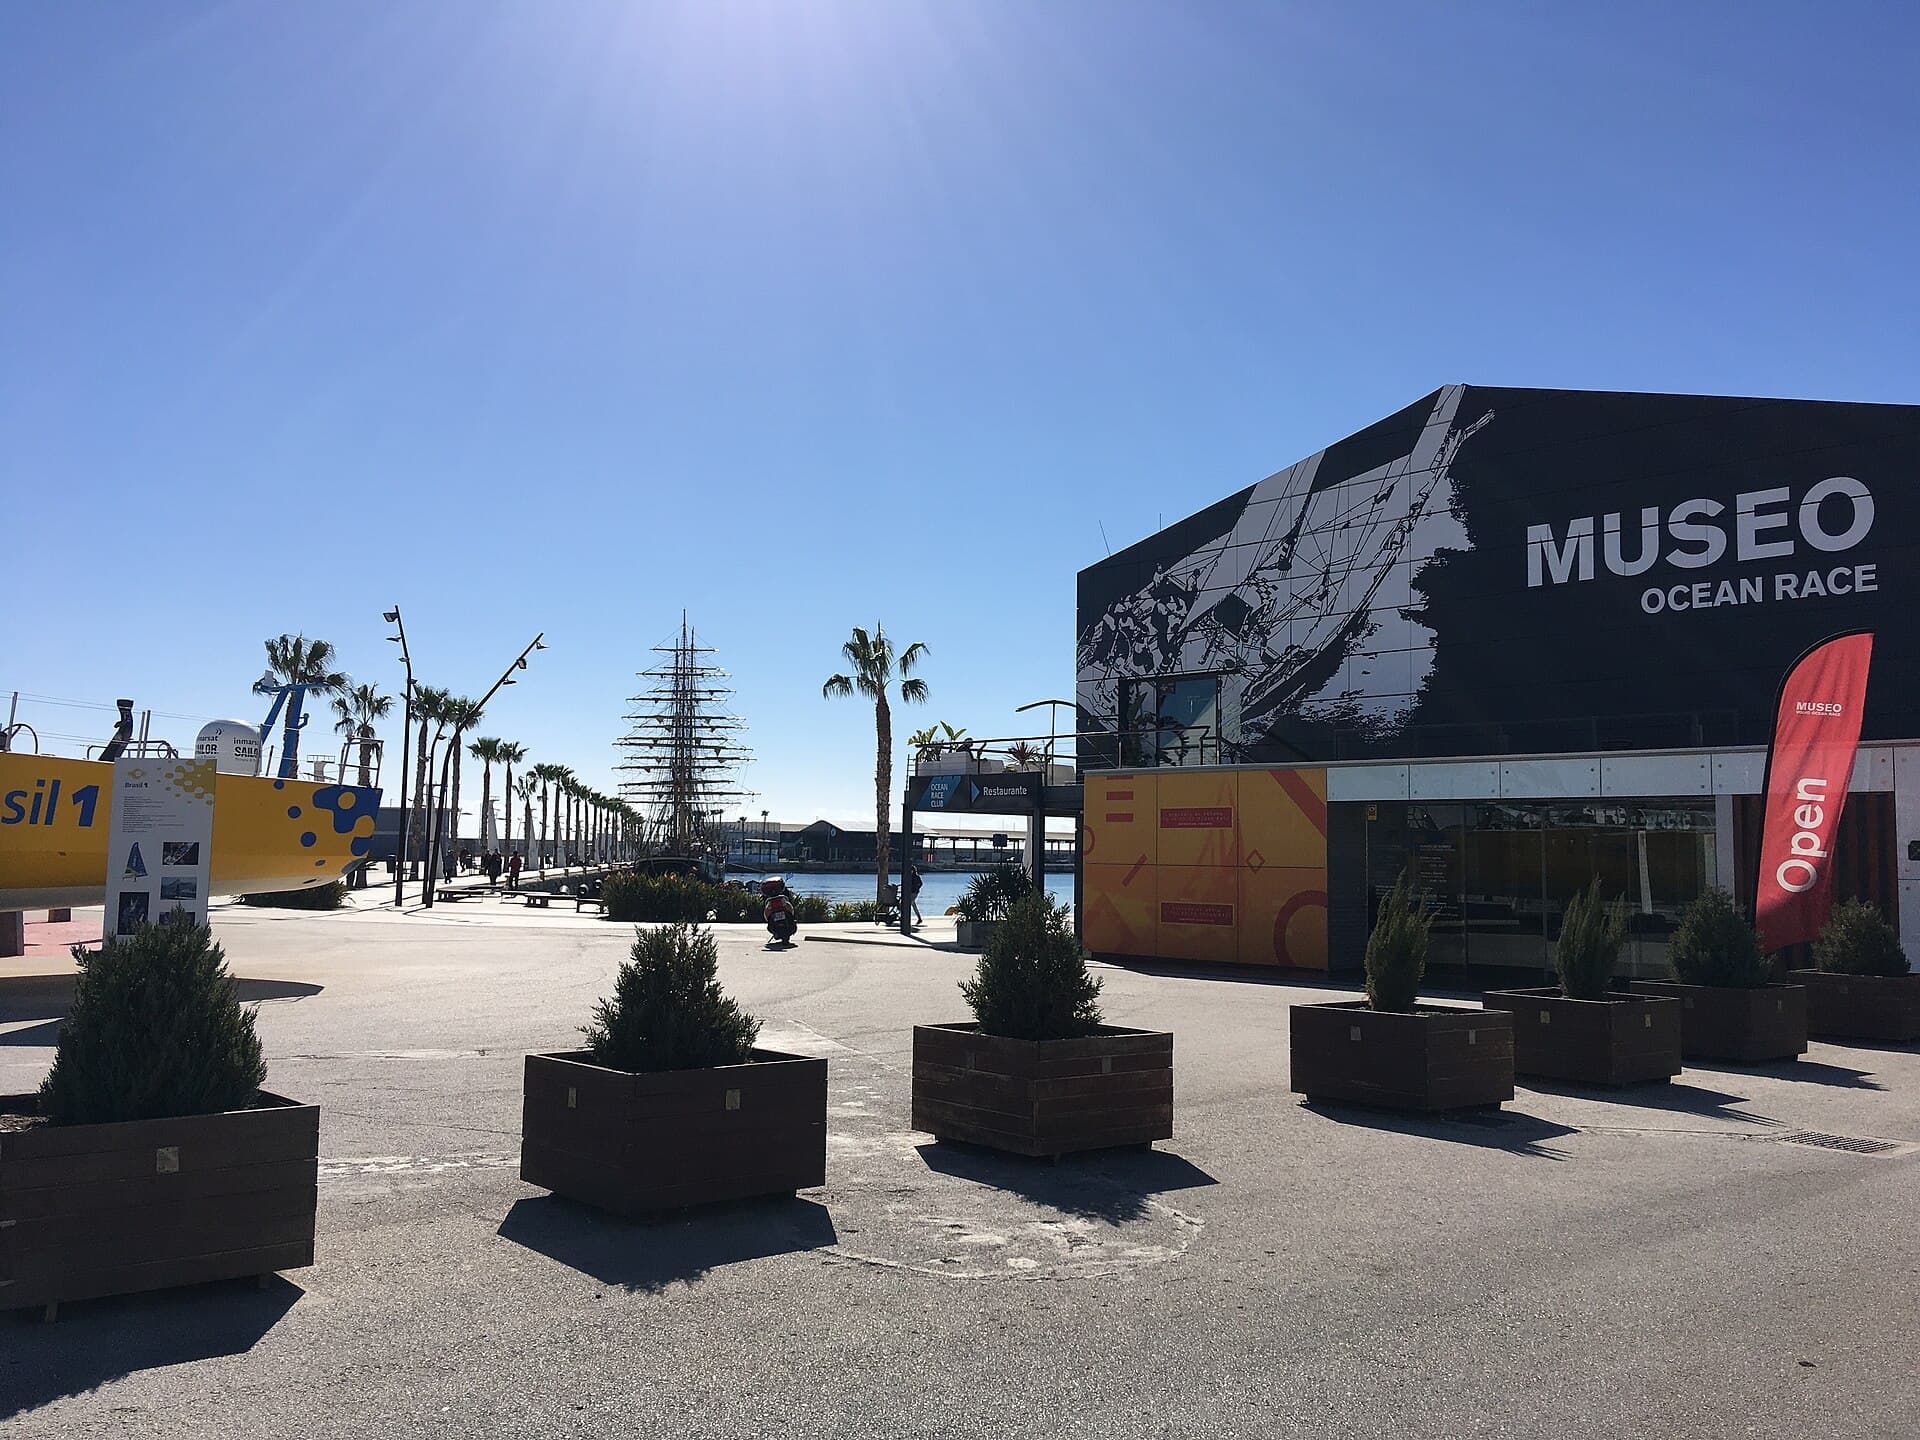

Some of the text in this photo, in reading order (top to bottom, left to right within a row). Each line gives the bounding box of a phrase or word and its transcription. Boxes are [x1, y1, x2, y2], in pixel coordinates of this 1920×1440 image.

[1527, 477, 1876, 587] MUSEO
[1641, 563, 1878, 614] OCEAN RACE
[1796, 701, 1842, 713] MUSEO
[1, 779, 61, 826] sil
[72, 785, 99, 827] 1
[931, 783, 948, 791] OCEAN
[983, 786, 1027, 796] Restaurante
[1776, 778, 1827, 892] Open
